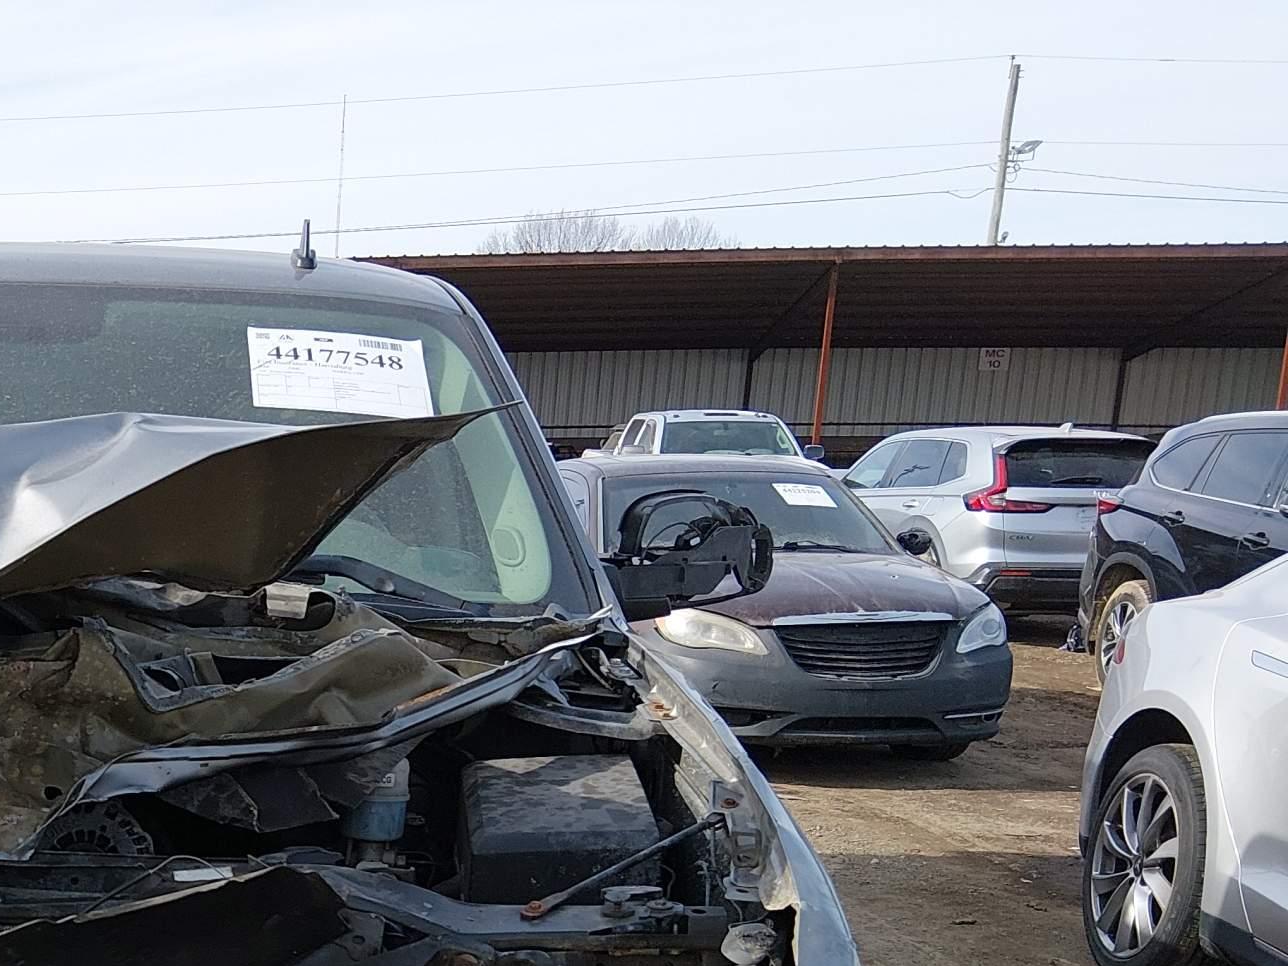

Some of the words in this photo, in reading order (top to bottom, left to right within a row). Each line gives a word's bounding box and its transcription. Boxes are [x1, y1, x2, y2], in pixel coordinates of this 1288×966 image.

[985, 349, 1005, 358] MC
[267, 346, 404, 371] 44177548
[987, 360, 1001, 368] 10
